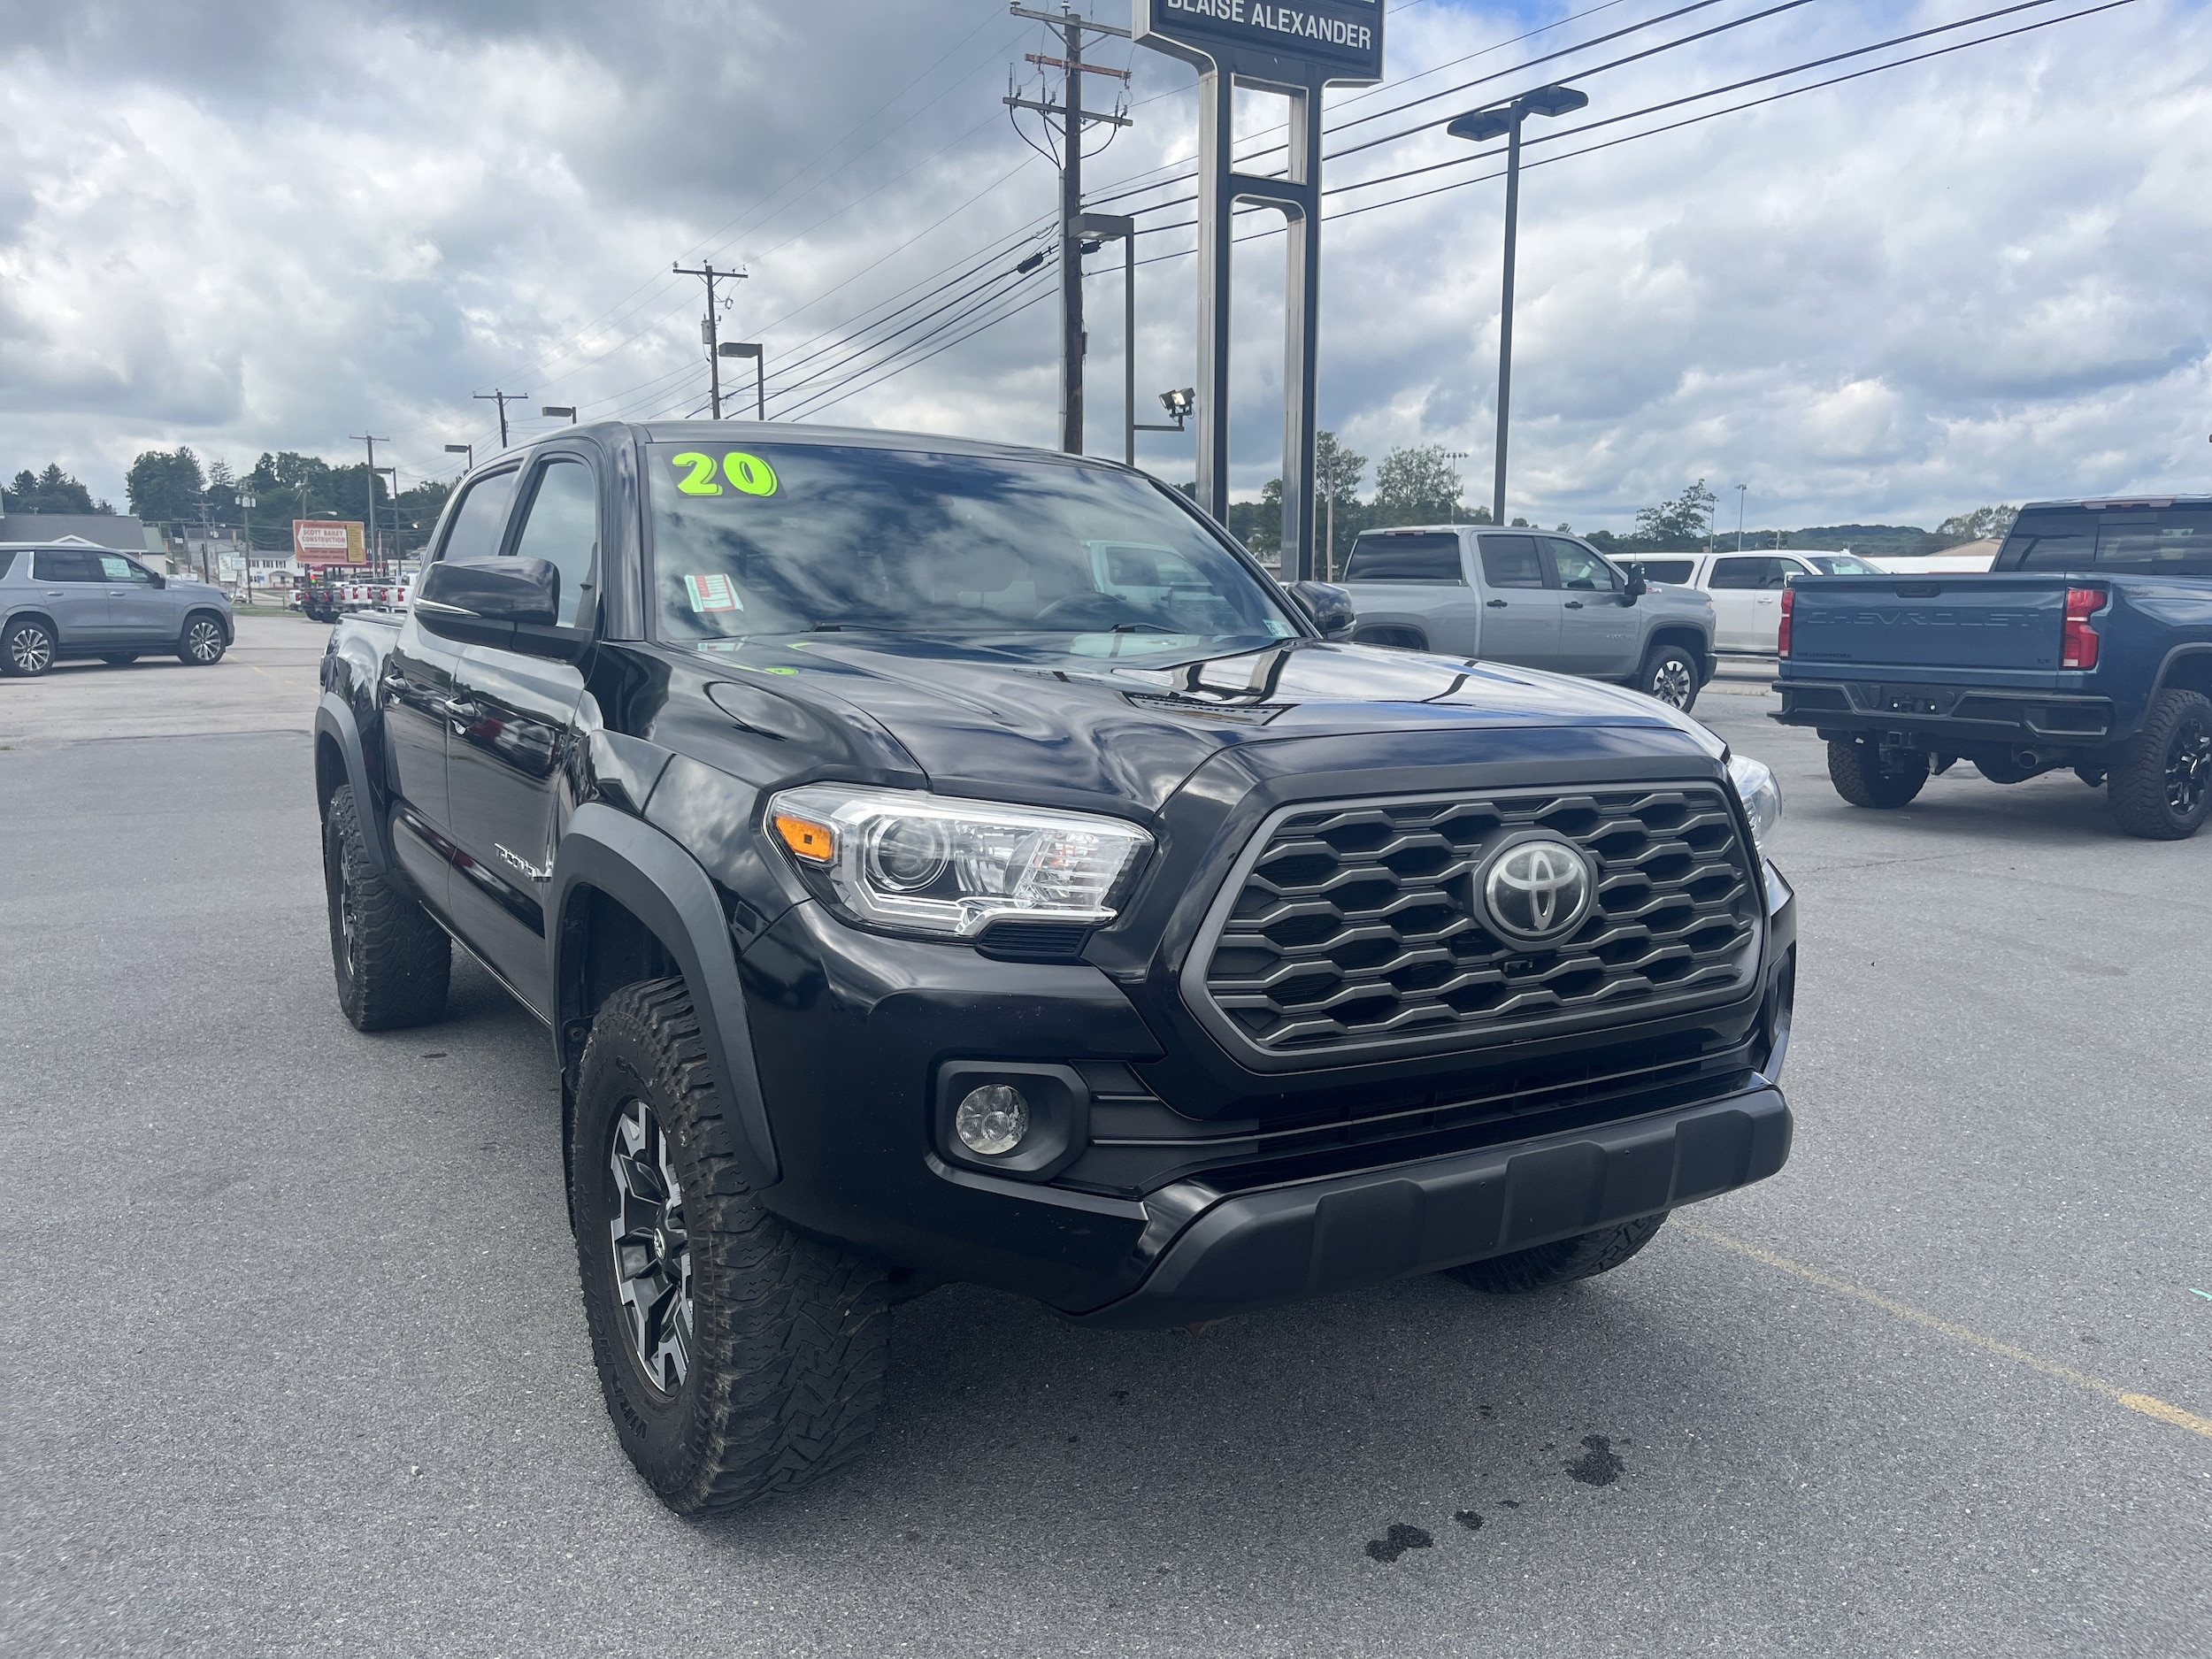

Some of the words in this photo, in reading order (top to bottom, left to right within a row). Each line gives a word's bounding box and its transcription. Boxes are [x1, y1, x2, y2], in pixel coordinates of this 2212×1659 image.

[1250, 3, 1371, 50] ALEXANDER
[672, 451, 778, 497] 20
[1808, 611, 2039, 627] CHEVROLET
